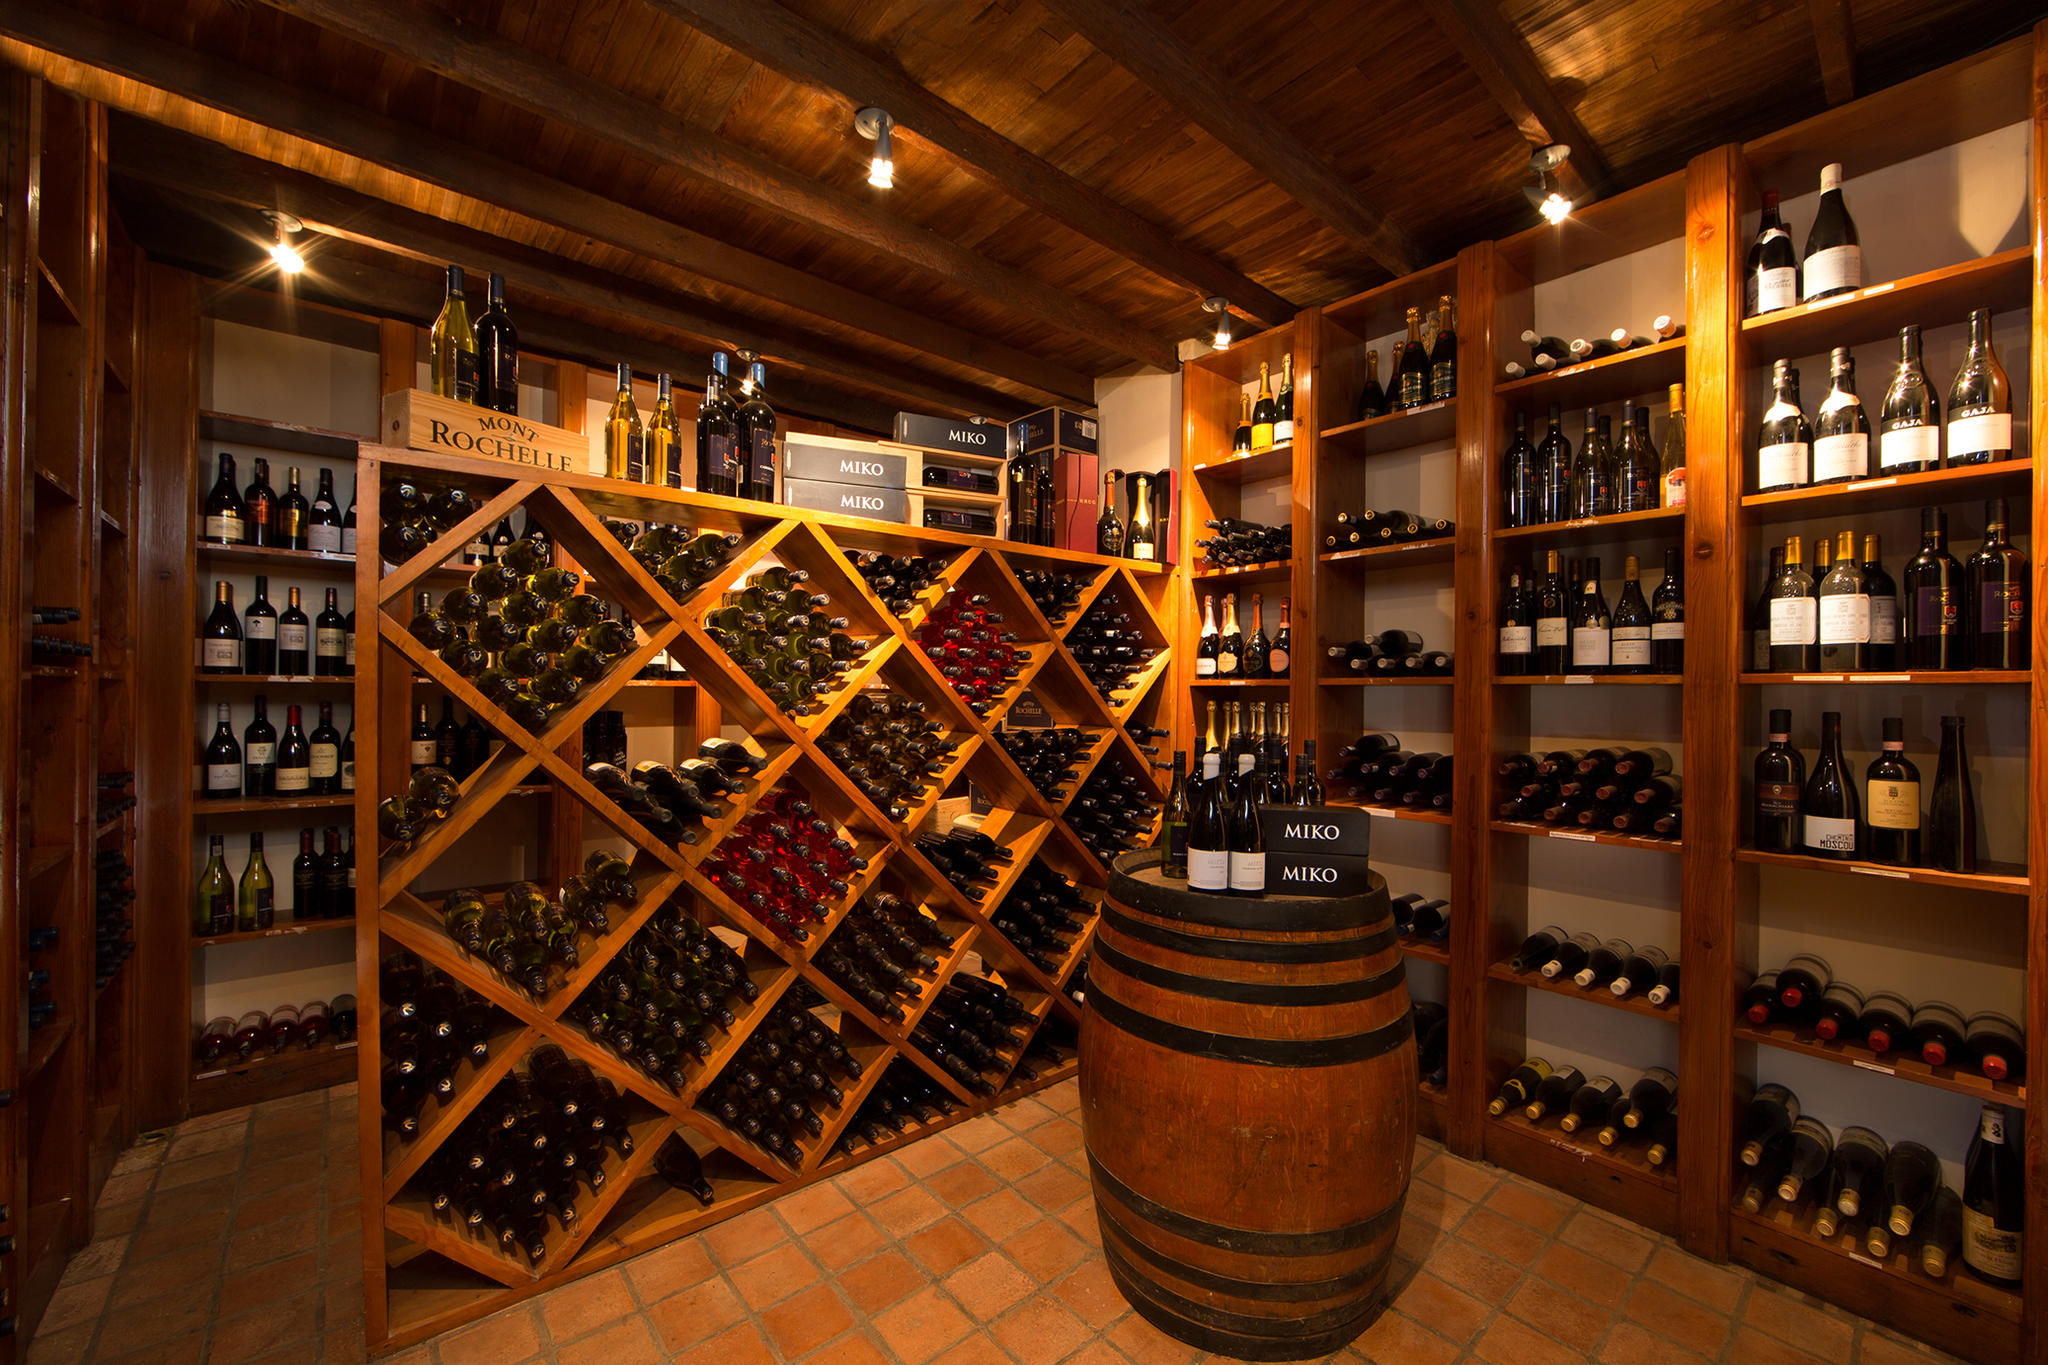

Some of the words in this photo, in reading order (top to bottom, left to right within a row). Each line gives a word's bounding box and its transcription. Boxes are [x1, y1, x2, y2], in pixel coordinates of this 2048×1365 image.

[1961, 406, 1996, 417] GAJA
[477, 416, 540, 443] MONT
[1891, 419, 1923, 430] GAJA
[430, 418, 573, 473] ROCHELLE
[948, 429, 987, 446] MIKO
[840, 459, 884, 477] MIKO
[840, 494, 885, 511] MIKO
[1284, 823, 1340, 841] MIKO
[1819, 839, 1854, 850] MOSCOU
[1282, 865, 1338, 884] MIKO
